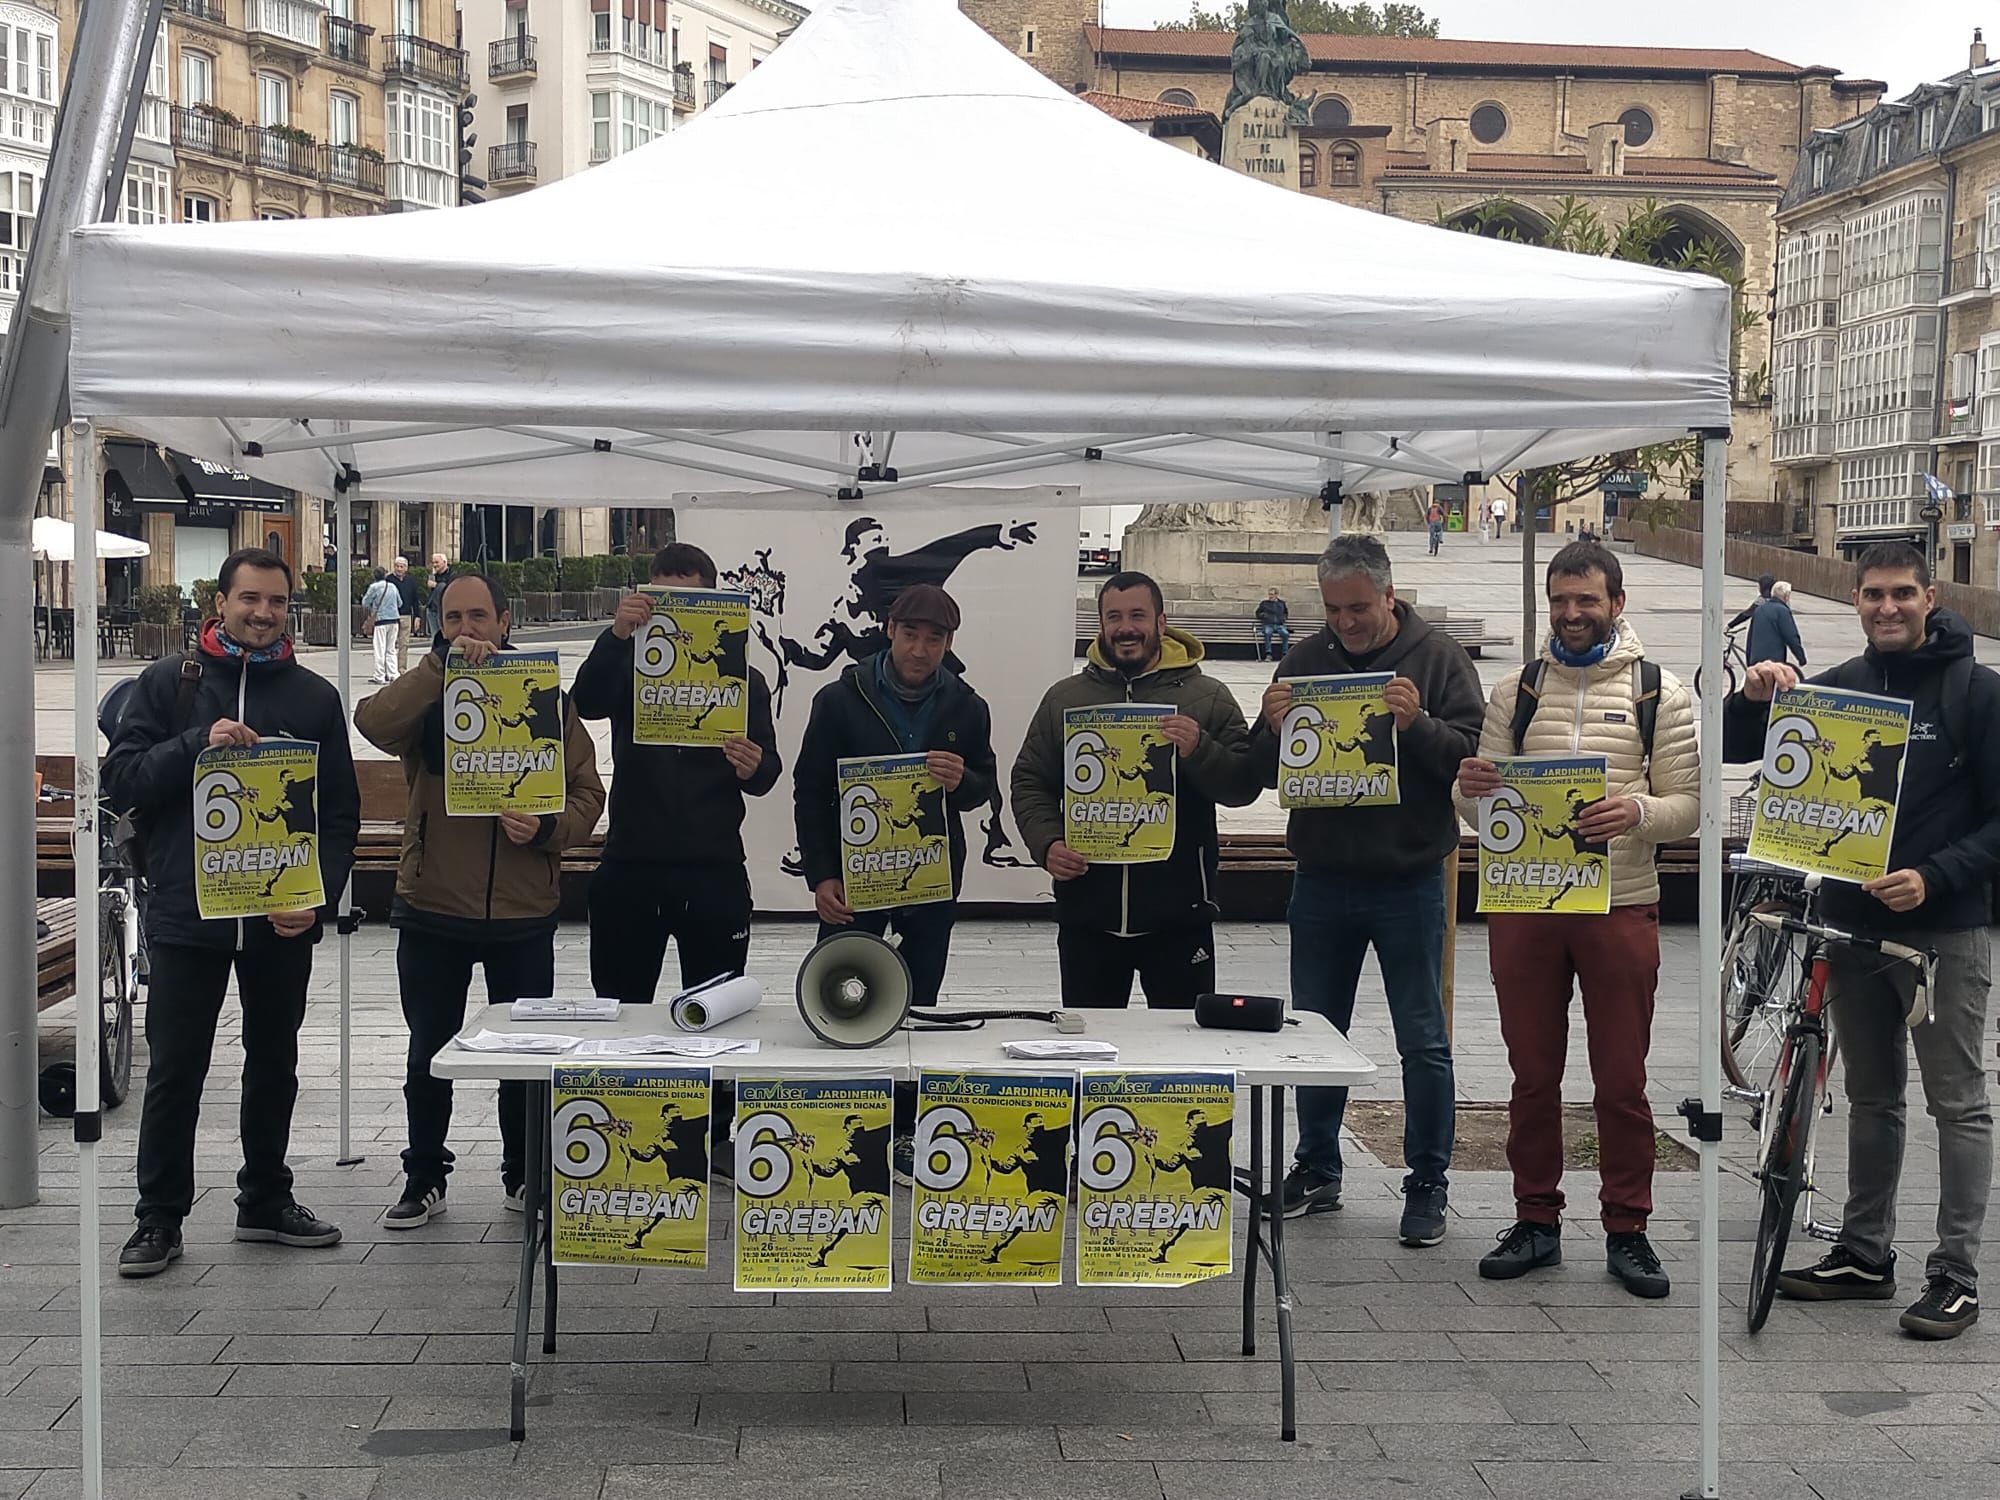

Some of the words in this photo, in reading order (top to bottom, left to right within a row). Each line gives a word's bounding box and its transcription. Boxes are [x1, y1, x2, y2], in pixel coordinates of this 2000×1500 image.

[1254, 108, 1260, 118] A
[1265, 107, 1276, 118] LA
[1243, 123, 1288, 138] BATALLA
[1260, 143, 1270, 153] DE
[1245, 159, 1285, 173] VITORIA
[1602, 474, 1632, 484] OMA
[695, 600, 746, 609] JARDINERIA
[675, 608, 719, 616] CONDICIONES
[636, 612, 677, 678] 6
[502, 659, 555, 667] JARDINERIA
[639, 684, 741, 707] GREBAN
[444, 676, 486, 744] 6
[1780, 689, 1836, 708] enviser
[1843, 704, 1905, 719] JARDINERIA
[1777, 705, 1793, 713] POR
[1795, 707, 1816, 716] UNAS
[1818, 710, 1872, 724] CONDICIONES
[1874, 719, 1905, 729] DIGNAS
[1281, 703, 1322, 770] 6
[257, 749, 312, 758] JARDINERIA
[453, 744, 529, 752] HILABETE
[1764, 713, 1815, 790] 6
[237, 760, 285, 768] CONDICIONES
[450, 750, 556, 773] GREBAN
[1066, 729, 1105, 795] 6
[1543, 768, 1601, 776] JARDINERIA
[1283, 775, 1390, 797] GREBAN
[195, 769, 241, 843] 6
[1070, 801, 1169, 824] GREBAN
[840, 783, 879, 846] 6
[1480, 784, 1525, 854] 6
[1761, 795, 1886, 837] GREBAN
[1775, 827, 1786, 835] 26
[201, 844, 312, 874] GREBAN
[847, 846, 942, 873] GREBAN
[1485, 861, 1602, 888] GREBAN
[561, 1067, 625, 1087] enviser
[634, 1078, 705, 1089] JARDINERIA
[1089, 1073, 1152, 1094] enviser
[1160, 1084, 1230, 1093] JARDINERIA
[744, 1079, 808, 1100] enviser
[817, 1090, 887, 1099] JARDINERIA
[927, 1074, 990, 1095] enviser
[999, 1086, 1068, 1098] JARDINERIA
[608, 1089, 668, 1098] CONDICIONES
[1134, 1096, 1194, 1104] CONDICIONES
[946, 1096, 969, 1104] UNAS
[972, 1097, 1032, 1108] CONDICIONES
[1034, 1101, 1068, 1109] DIGNAS
[554, 1096, 610, 1180] 6
[737, 1110, 793, 1199] 6
[916, 1103, 972, 1193] 6
[1081, 1104, 1136, 1193] 6
[564, 1180, 663, 1192] HILABETE
[559, 1188, 700, 1219] GREBAN
[746, 1200, 846, 1208] HILABETE
[923, 1193, 1022, 1206] HILABETE
[1089, 1193, 1187, 1203] HILABETE
[566, 1213, 650, 1225] MESES
[742, 1207, 882, 1234] GREBAN
[918, 1201, 1058, 1234] GREBAN
[1084, 1201, 1223, 1230] GREBAN
[578, 1222, 591, 1230] 26
[1090, 1227, 1174, 1237] MESES
[578, 1231, 629, 1239] MANIFESTAZIOA
[748, 1234, 833, 1242] MESES
[923, 1228, 1008, 1241] MESES
[1103, 1237, 1115, 1245] 26
[936, 1238, 949, 1246] 26
[935, 1247, 986, 1256] MANIFESTAZIOA
[814, 1273, 840, 1283] hemen
[986, 1267, 1013, 1278] hemen
[1155, 1269, 1182, 1279] hemen
